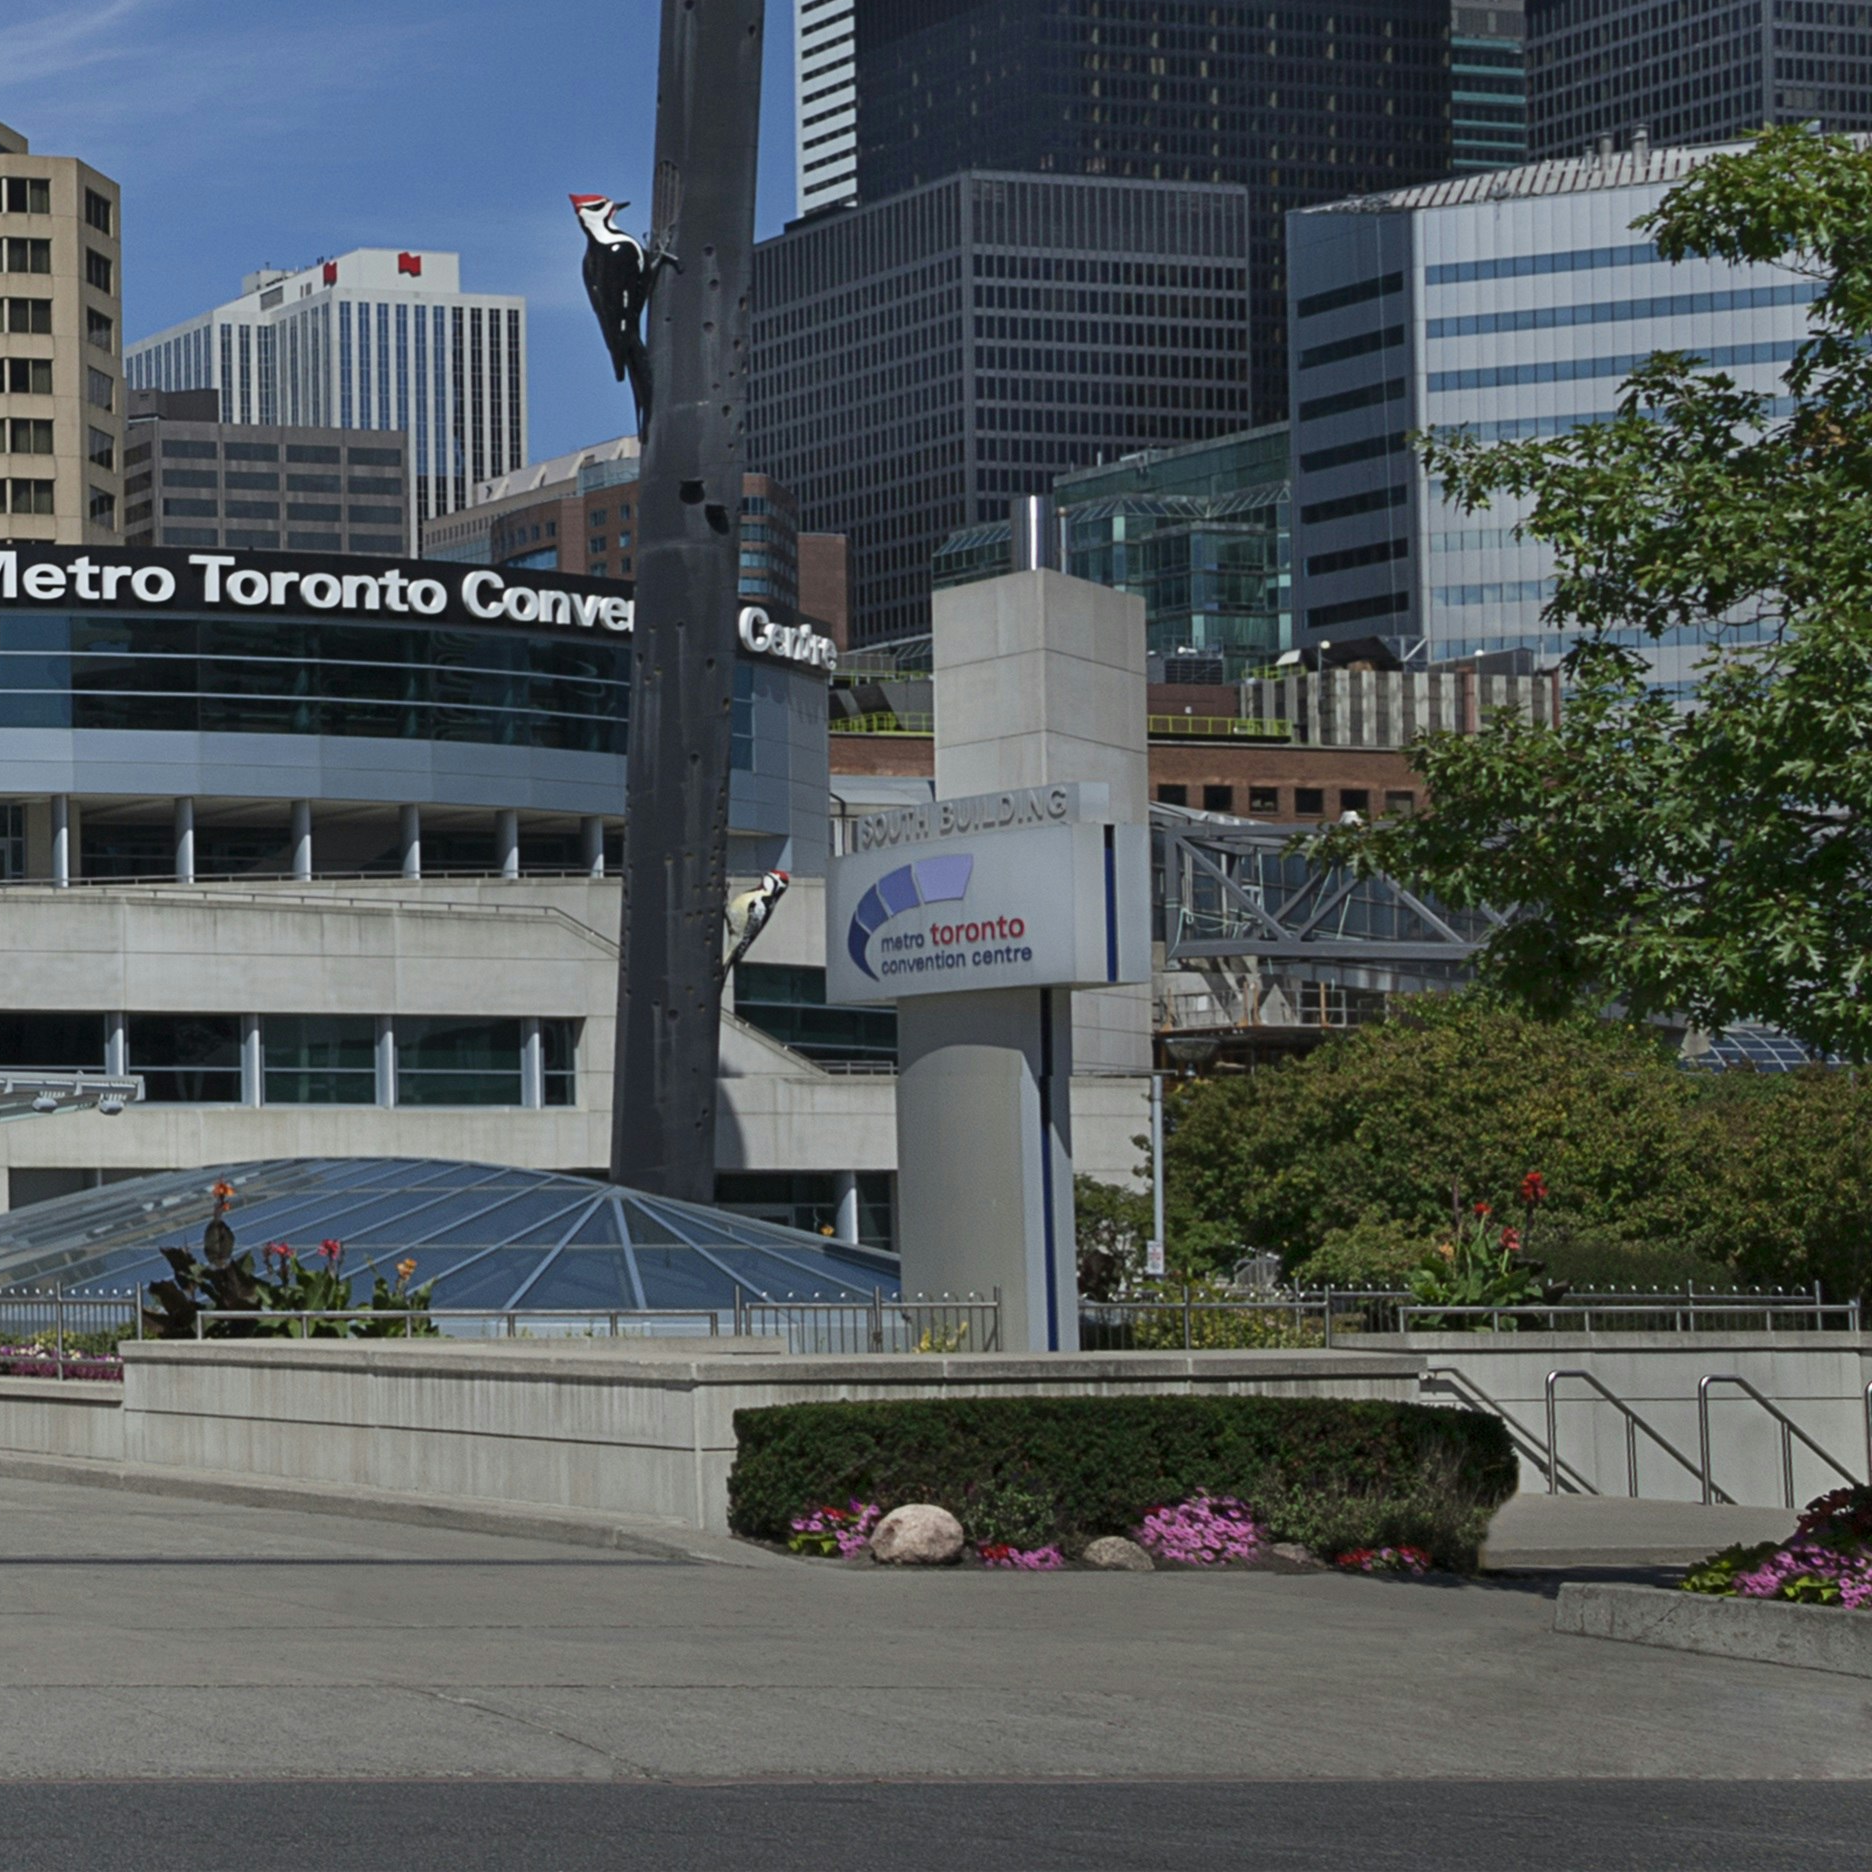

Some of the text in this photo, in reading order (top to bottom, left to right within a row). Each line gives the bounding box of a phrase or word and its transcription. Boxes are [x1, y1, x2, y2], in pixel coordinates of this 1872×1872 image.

[188, 554, 448, 615] Toronto
[461, 570, 635, 633] Conve
[738, 606, 838, 671] Centre
[860, 785, 1069, 851] SOUTH BUILDING
[880, 915, 1026, 954] metro toronto
[880, 945, 1033, 976] convention centre
